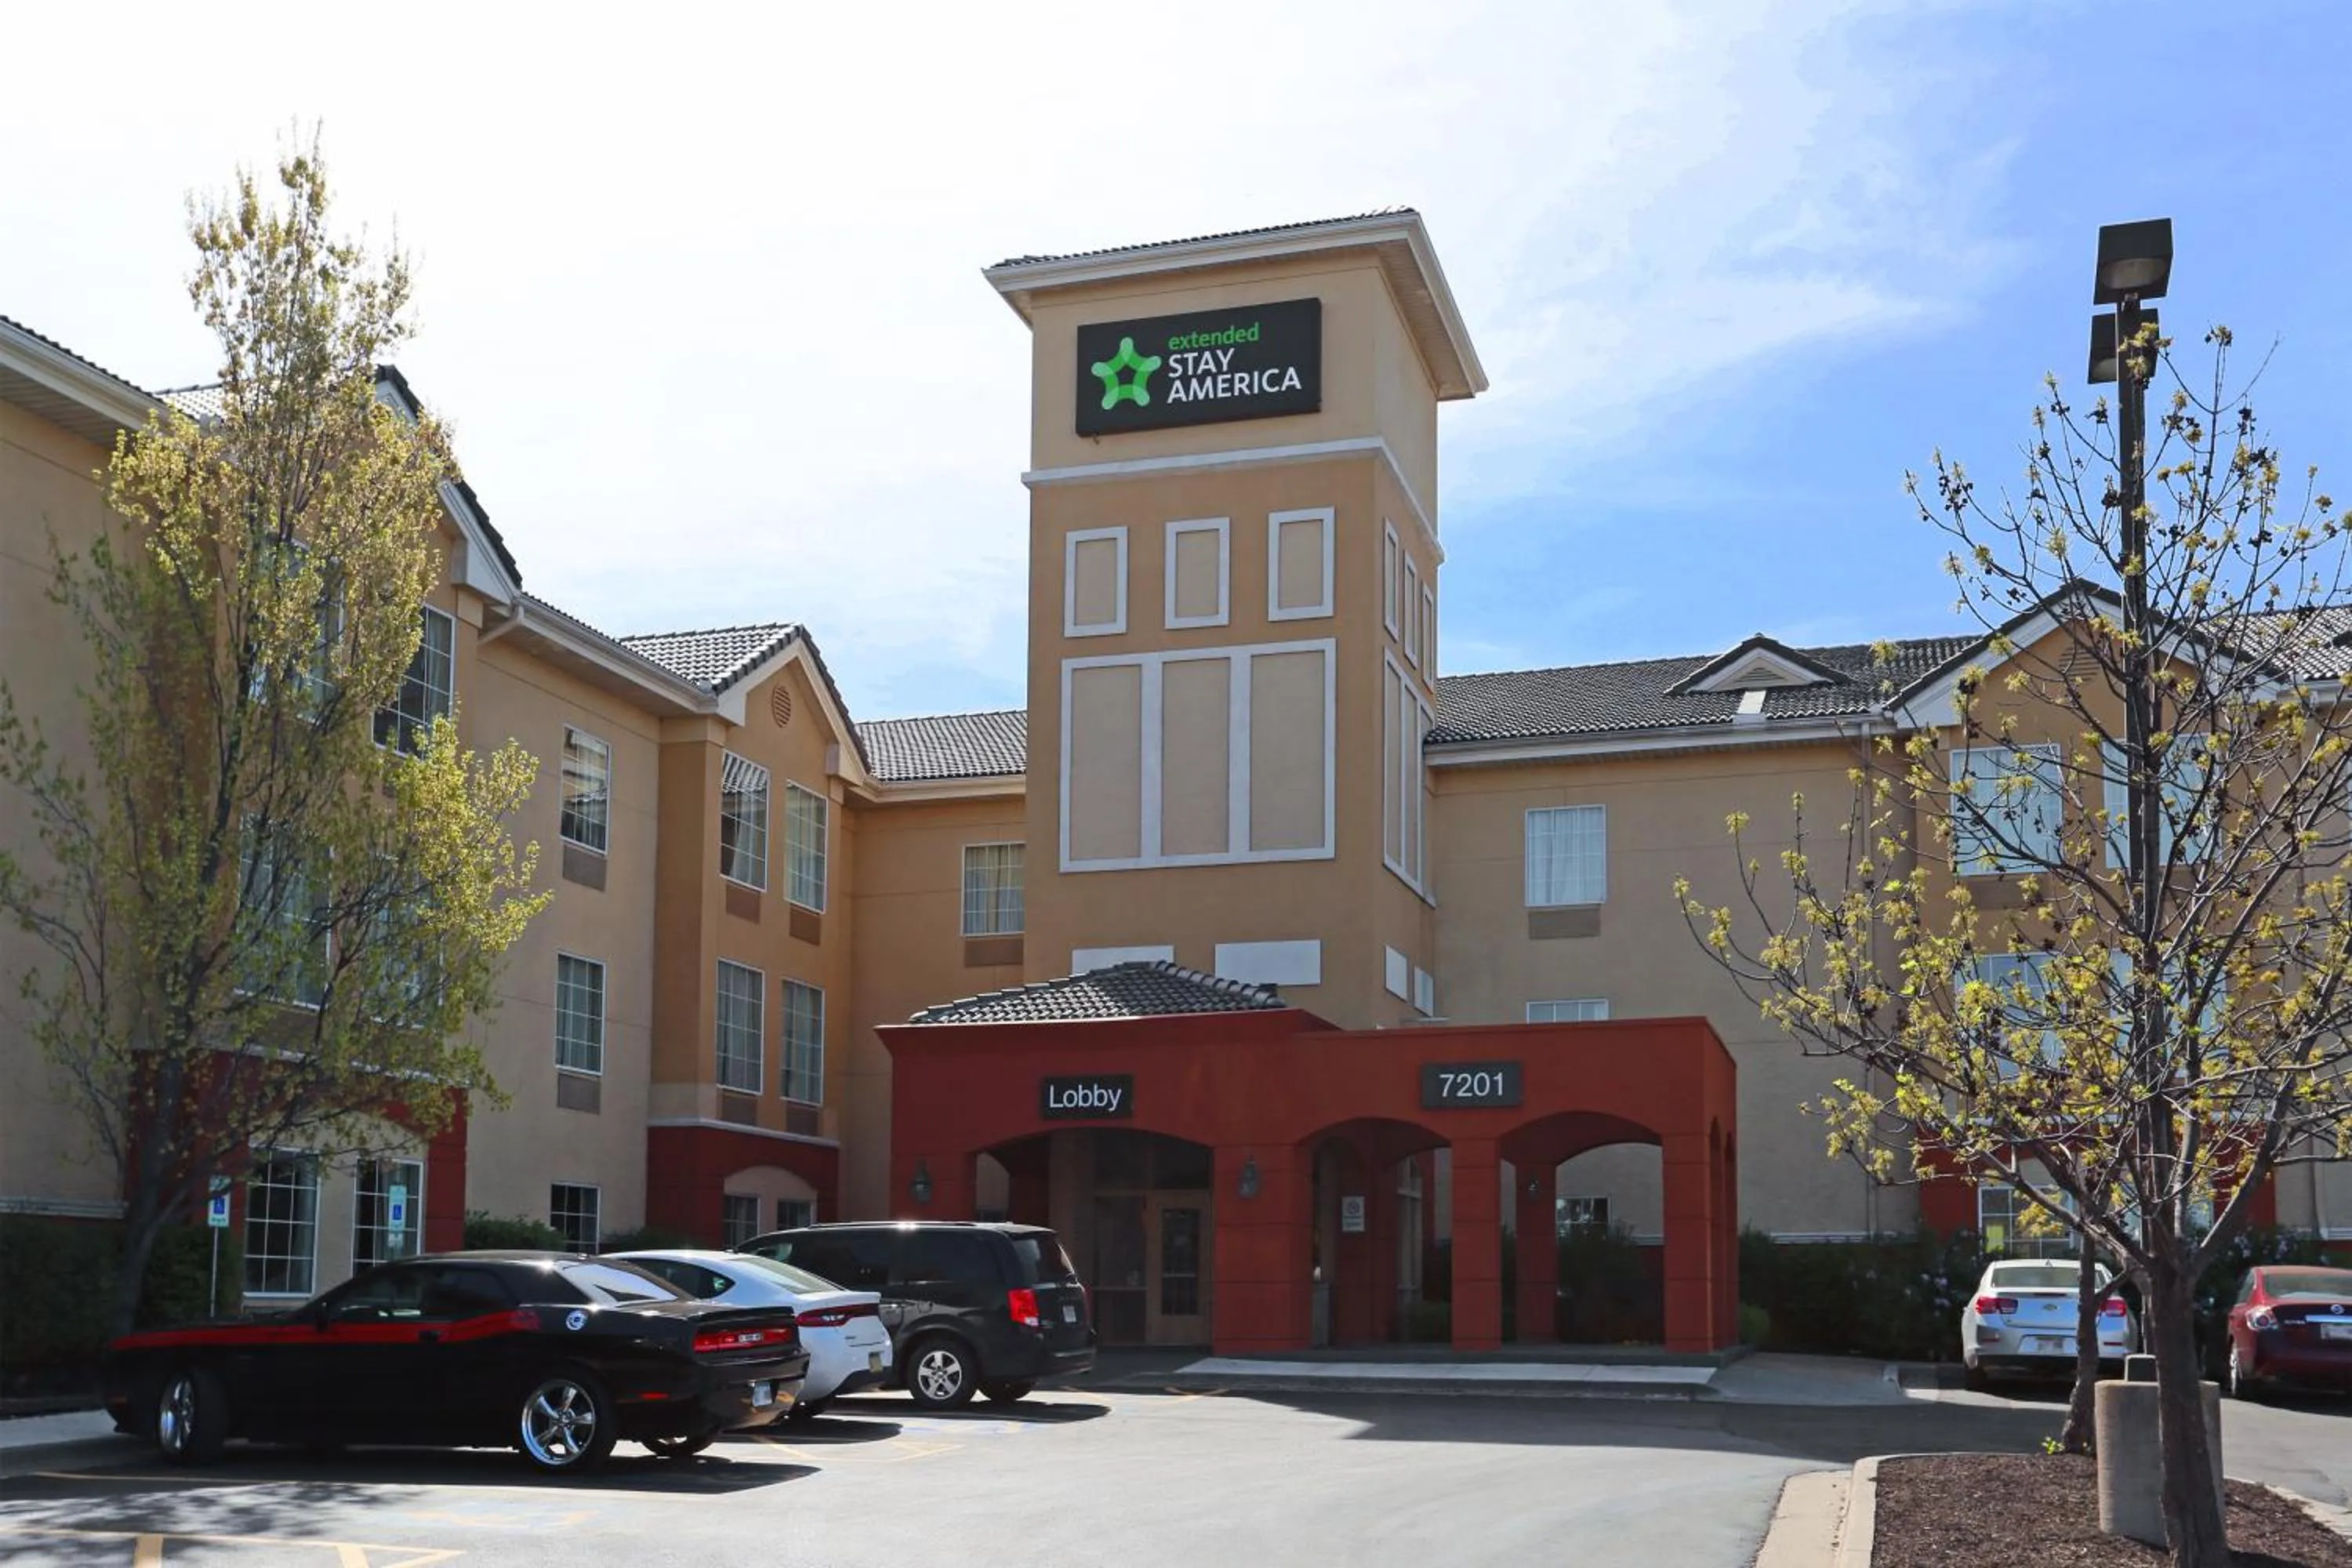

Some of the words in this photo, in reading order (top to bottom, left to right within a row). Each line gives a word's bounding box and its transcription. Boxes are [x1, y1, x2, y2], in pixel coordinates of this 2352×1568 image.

[1168, 322, 1259, 350] extended
[1168, 348, 1235, 378] STAY
[1167, 367, 1302, 404] AMERICA
[1049, 1083, 1122, 1112] Lobby
[1439, 1072, 1504, 1098] 7201
